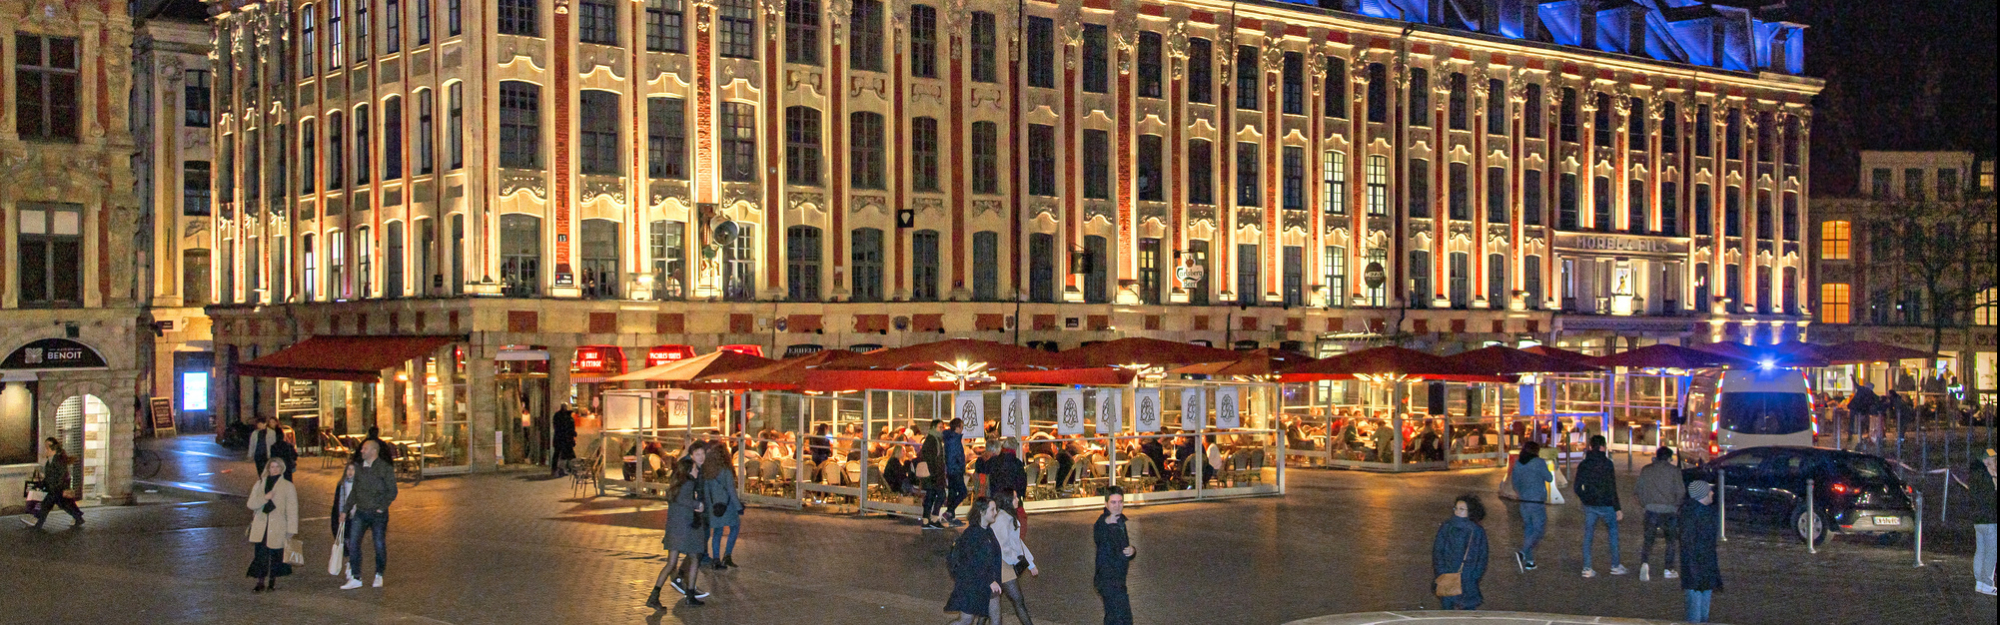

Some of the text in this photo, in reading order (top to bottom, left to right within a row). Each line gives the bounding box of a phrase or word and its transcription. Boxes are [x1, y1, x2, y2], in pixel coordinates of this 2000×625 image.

[1576, 236, 1624, 250] MOREL
[1638, 240, 1668, 252] FILS
[1177, 267, 1203, 280] Carlsberg
[48, 351, 82, 359] BENOIT
